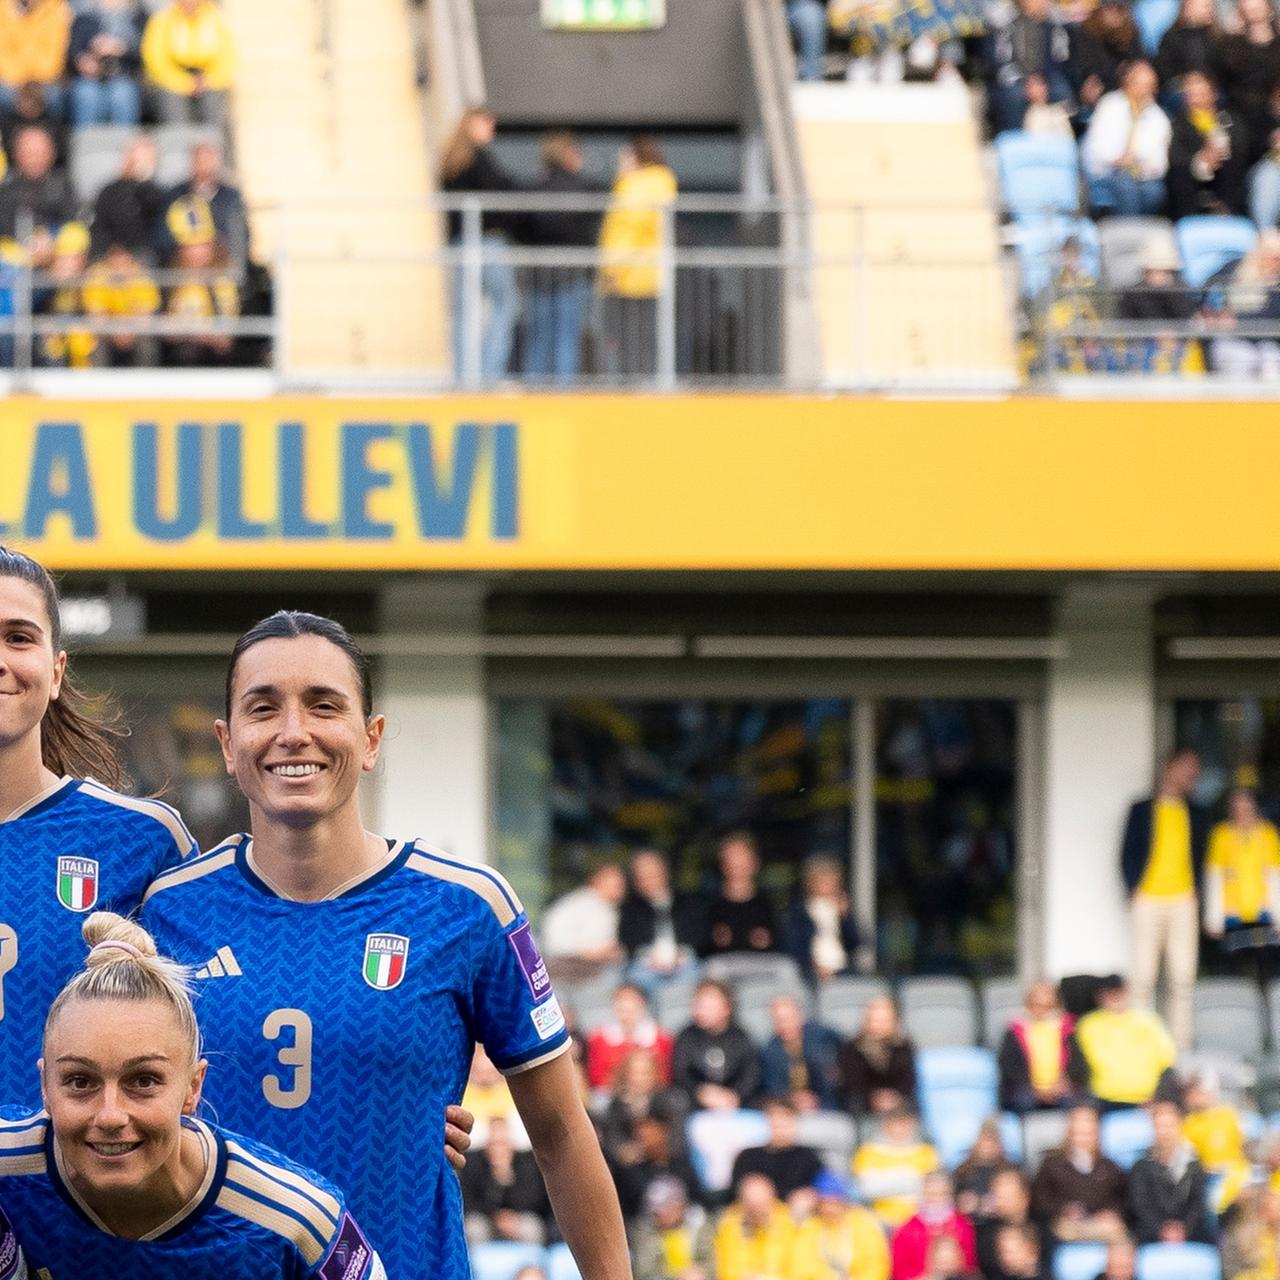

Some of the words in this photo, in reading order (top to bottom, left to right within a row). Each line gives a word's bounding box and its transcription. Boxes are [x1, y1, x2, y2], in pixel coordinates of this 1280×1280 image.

[132, 423, 520, 541] ULLEVI
[60, 860, 95, 875] ITALIA
[368, 938, 405, 951] ITALIA
[261, 1007, 313, 1109] 3
